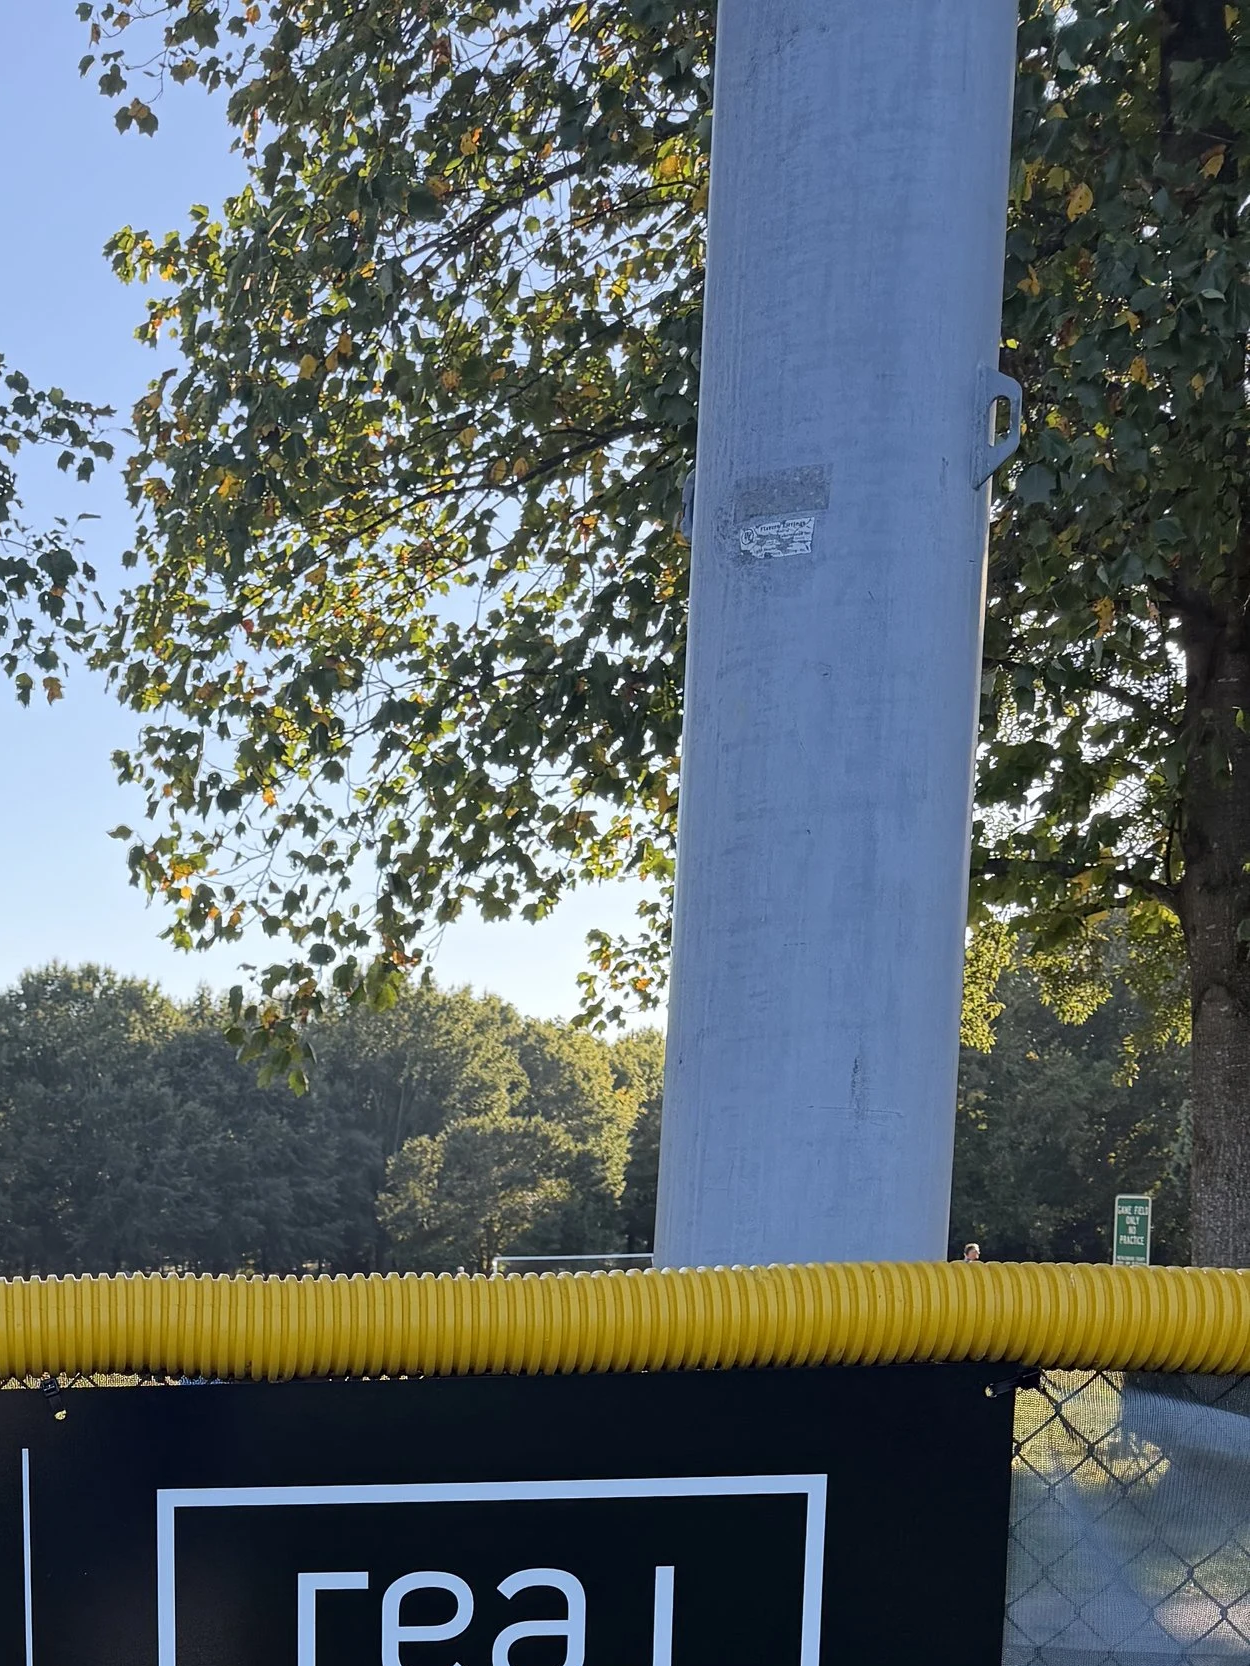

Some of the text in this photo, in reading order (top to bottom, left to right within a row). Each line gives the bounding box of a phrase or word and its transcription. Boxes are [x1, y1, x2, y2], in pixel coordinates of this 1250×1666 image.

[1117, 1205, 1132, 1215] GAME
[1125, 1215, 1140, 1225] ONLY
[1128, 1225, 1137, 1235] NO
[1119, 1235, 1145, 1245] PRACTICE
